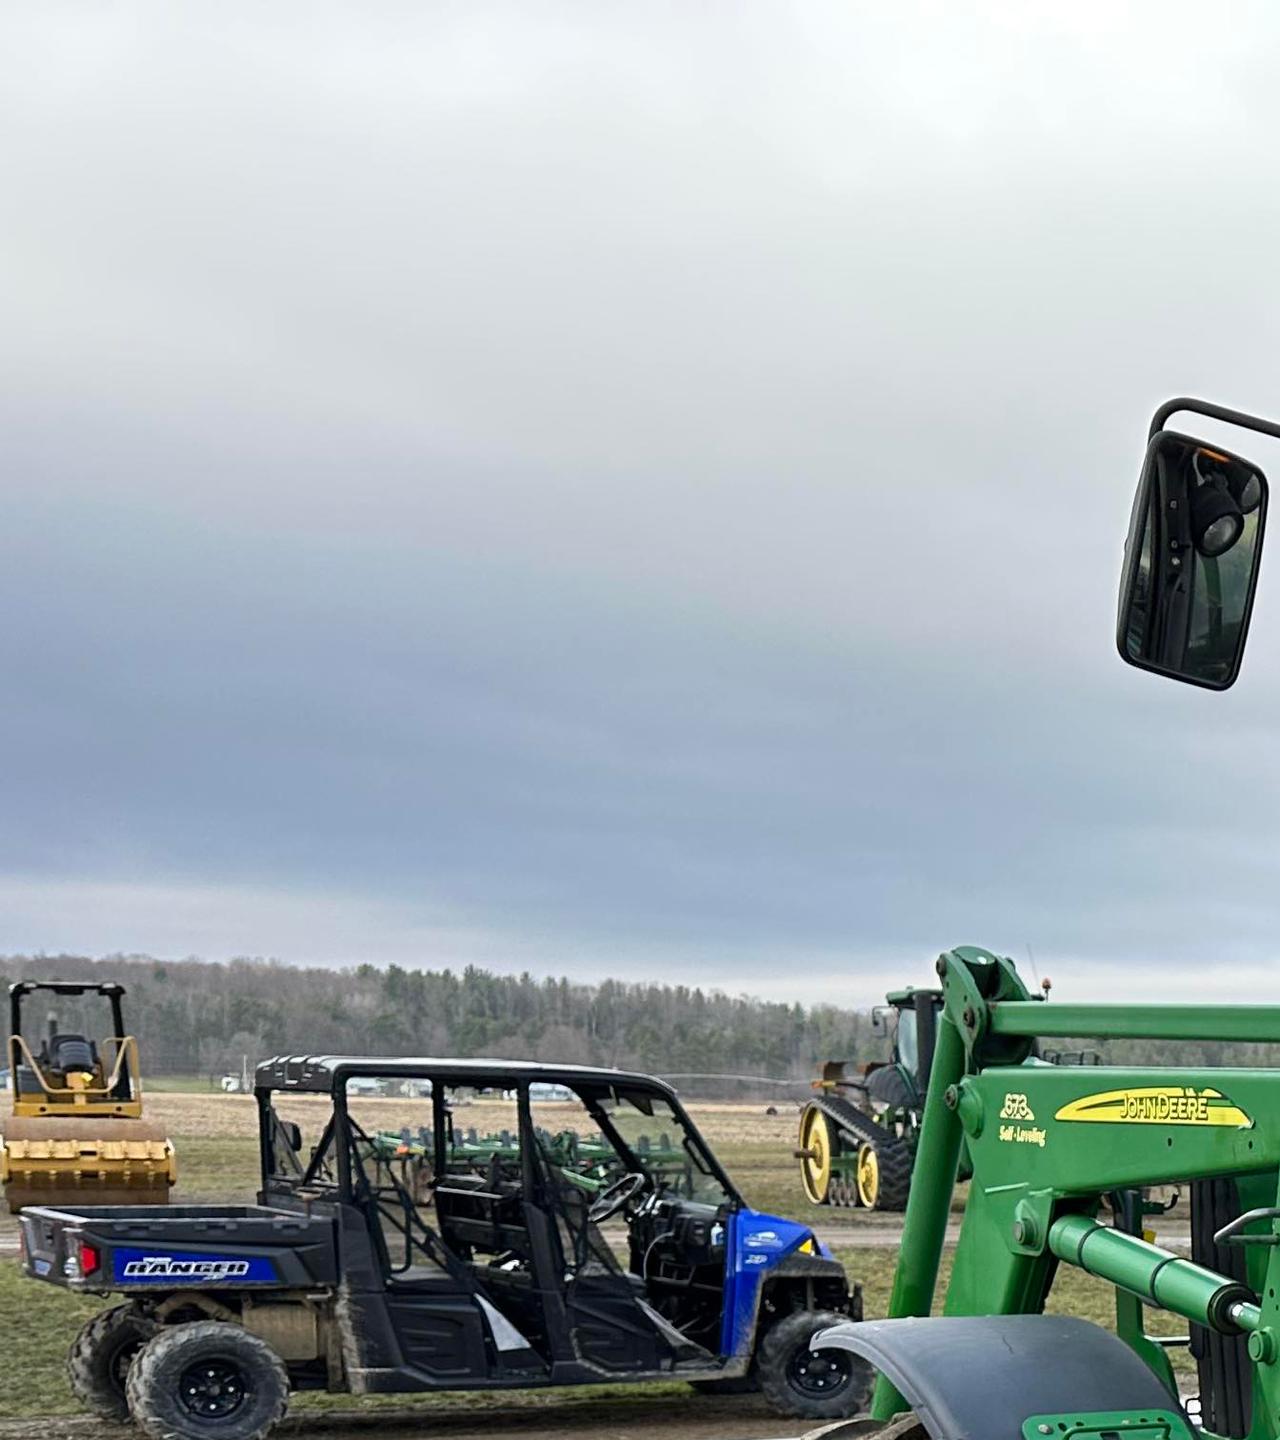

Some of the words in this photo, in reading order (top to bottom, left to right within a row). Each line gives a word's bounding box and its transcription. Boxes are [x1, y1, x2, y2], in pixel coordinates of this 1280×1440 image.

[1002, 1093, 1031, 1118] 673
[1120, 1093, 1156, 1119] JOHN
[1157, 1092, 1208, 1121] DEERE
[123, 1261, 249, 1277] RANGER
